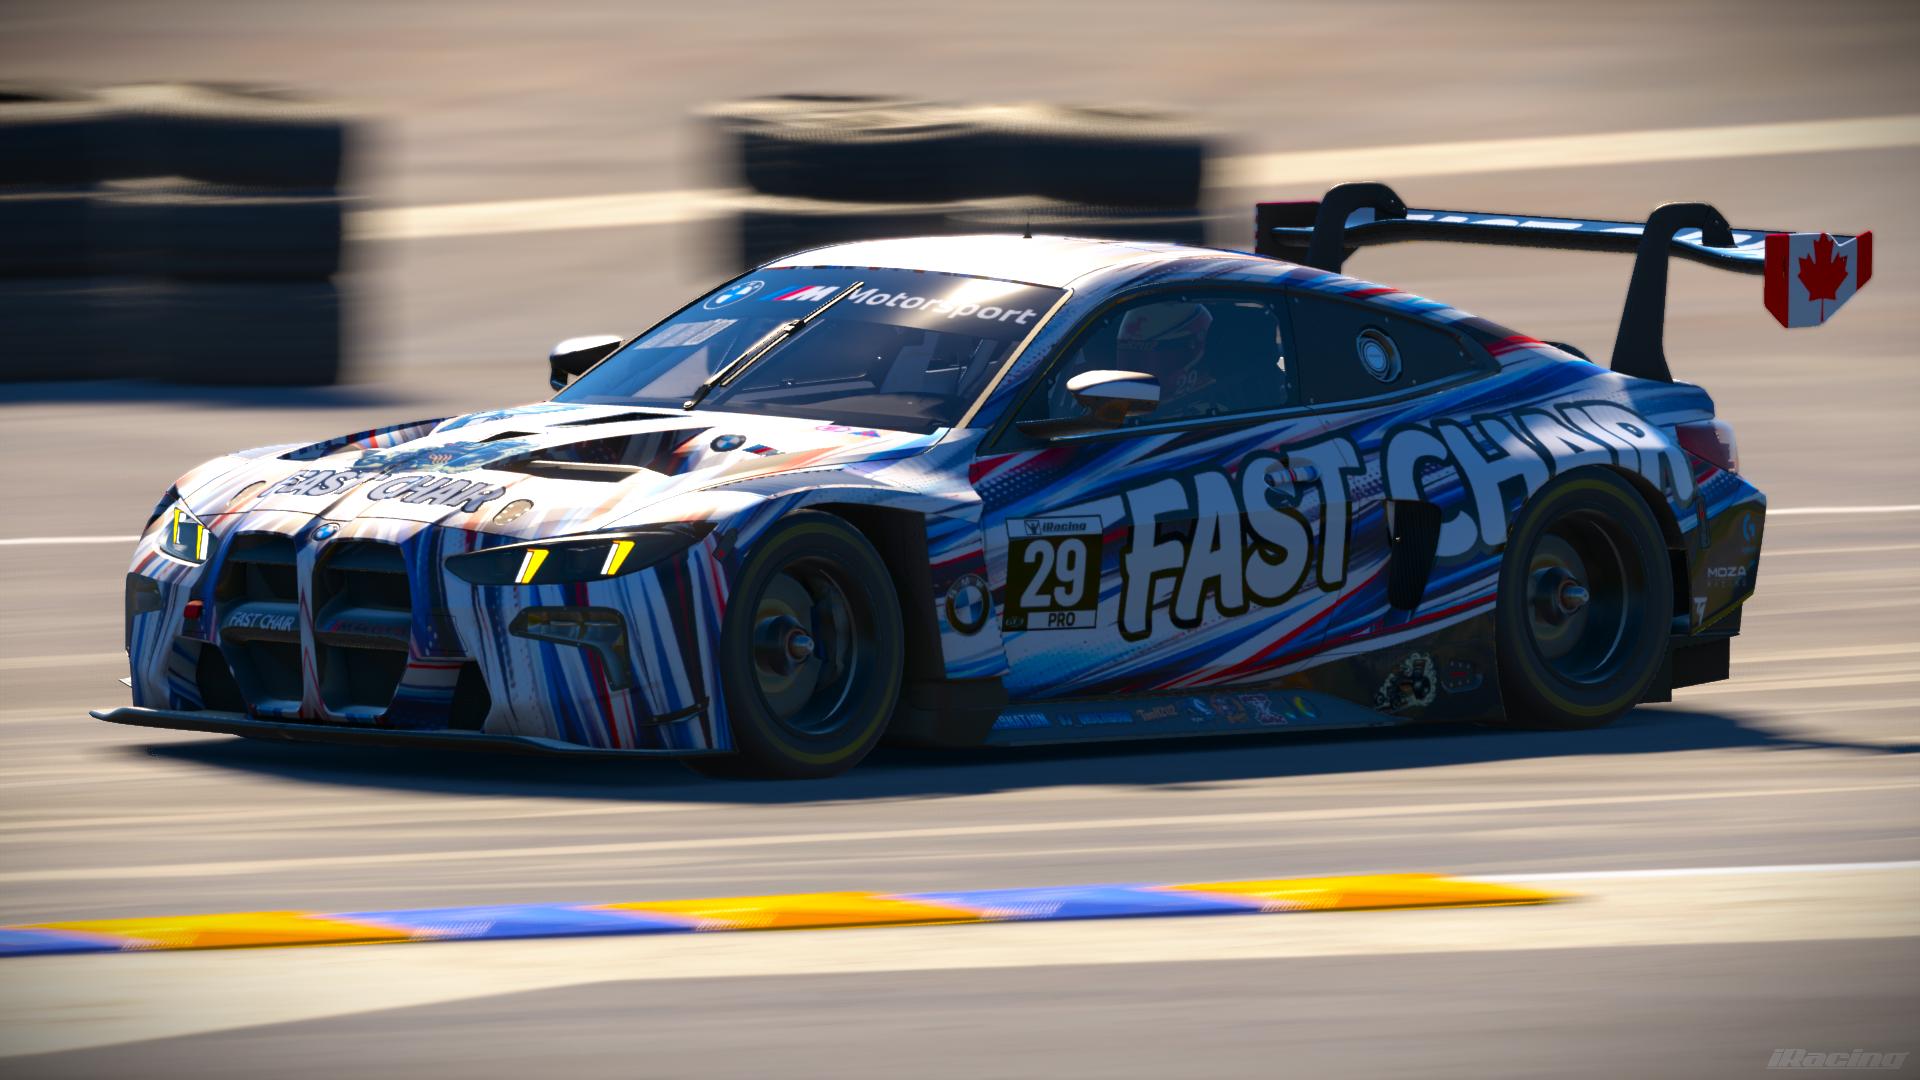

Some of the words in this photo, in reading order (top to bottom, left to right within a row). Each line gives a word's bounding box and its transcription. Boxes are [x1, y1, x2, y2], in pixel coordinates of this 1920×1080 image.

[847, 286, 1037, 326] Motorsport
[258, 470, 391, 498] FAST
[367, 475, 506, 513] CHAIR
[1043, 521, 1087, 532] iRacing
[1118, 432, 1367, 641] FAST
[1020, 538, 1088, 609] 29
[1707, 565, 1747, 577] MOZA
[229, 611, 262, 628] FAST
[259, 614, 296, 632] CHAIR
[1048, 612, 1075, 627] PRO
